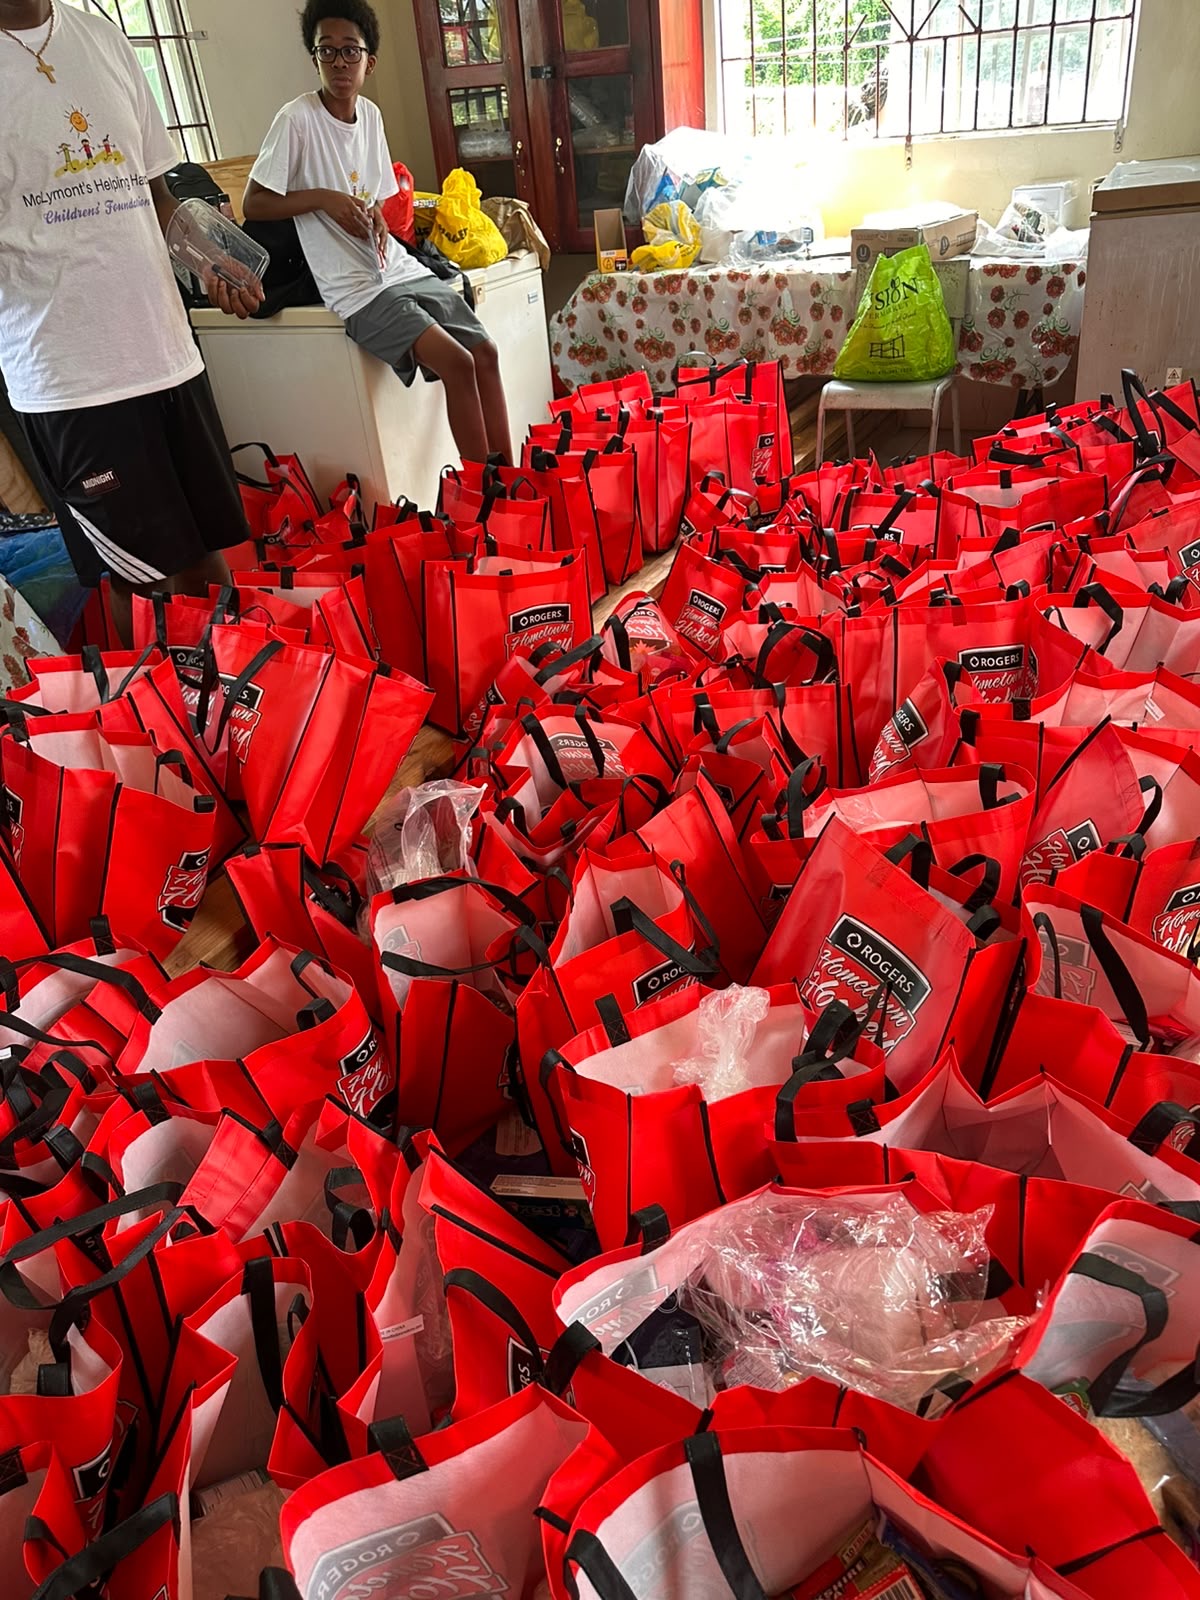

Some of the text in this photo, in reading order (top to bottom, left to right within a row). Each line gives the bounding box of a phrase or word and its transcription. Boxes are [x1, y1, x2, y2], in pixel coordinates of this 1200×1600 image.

[22, 182, 93, 208] McLymont's
[529, 610, 562, 624] ROGERS
[698, 598, 721, 616] ROGERS
[511, 624, 570, 651] Hometown
[981, 653, 1020, 667] ROGERS
[896, 707, 916, 733] GERS
[861, 944, 915, 994] ROGERS
